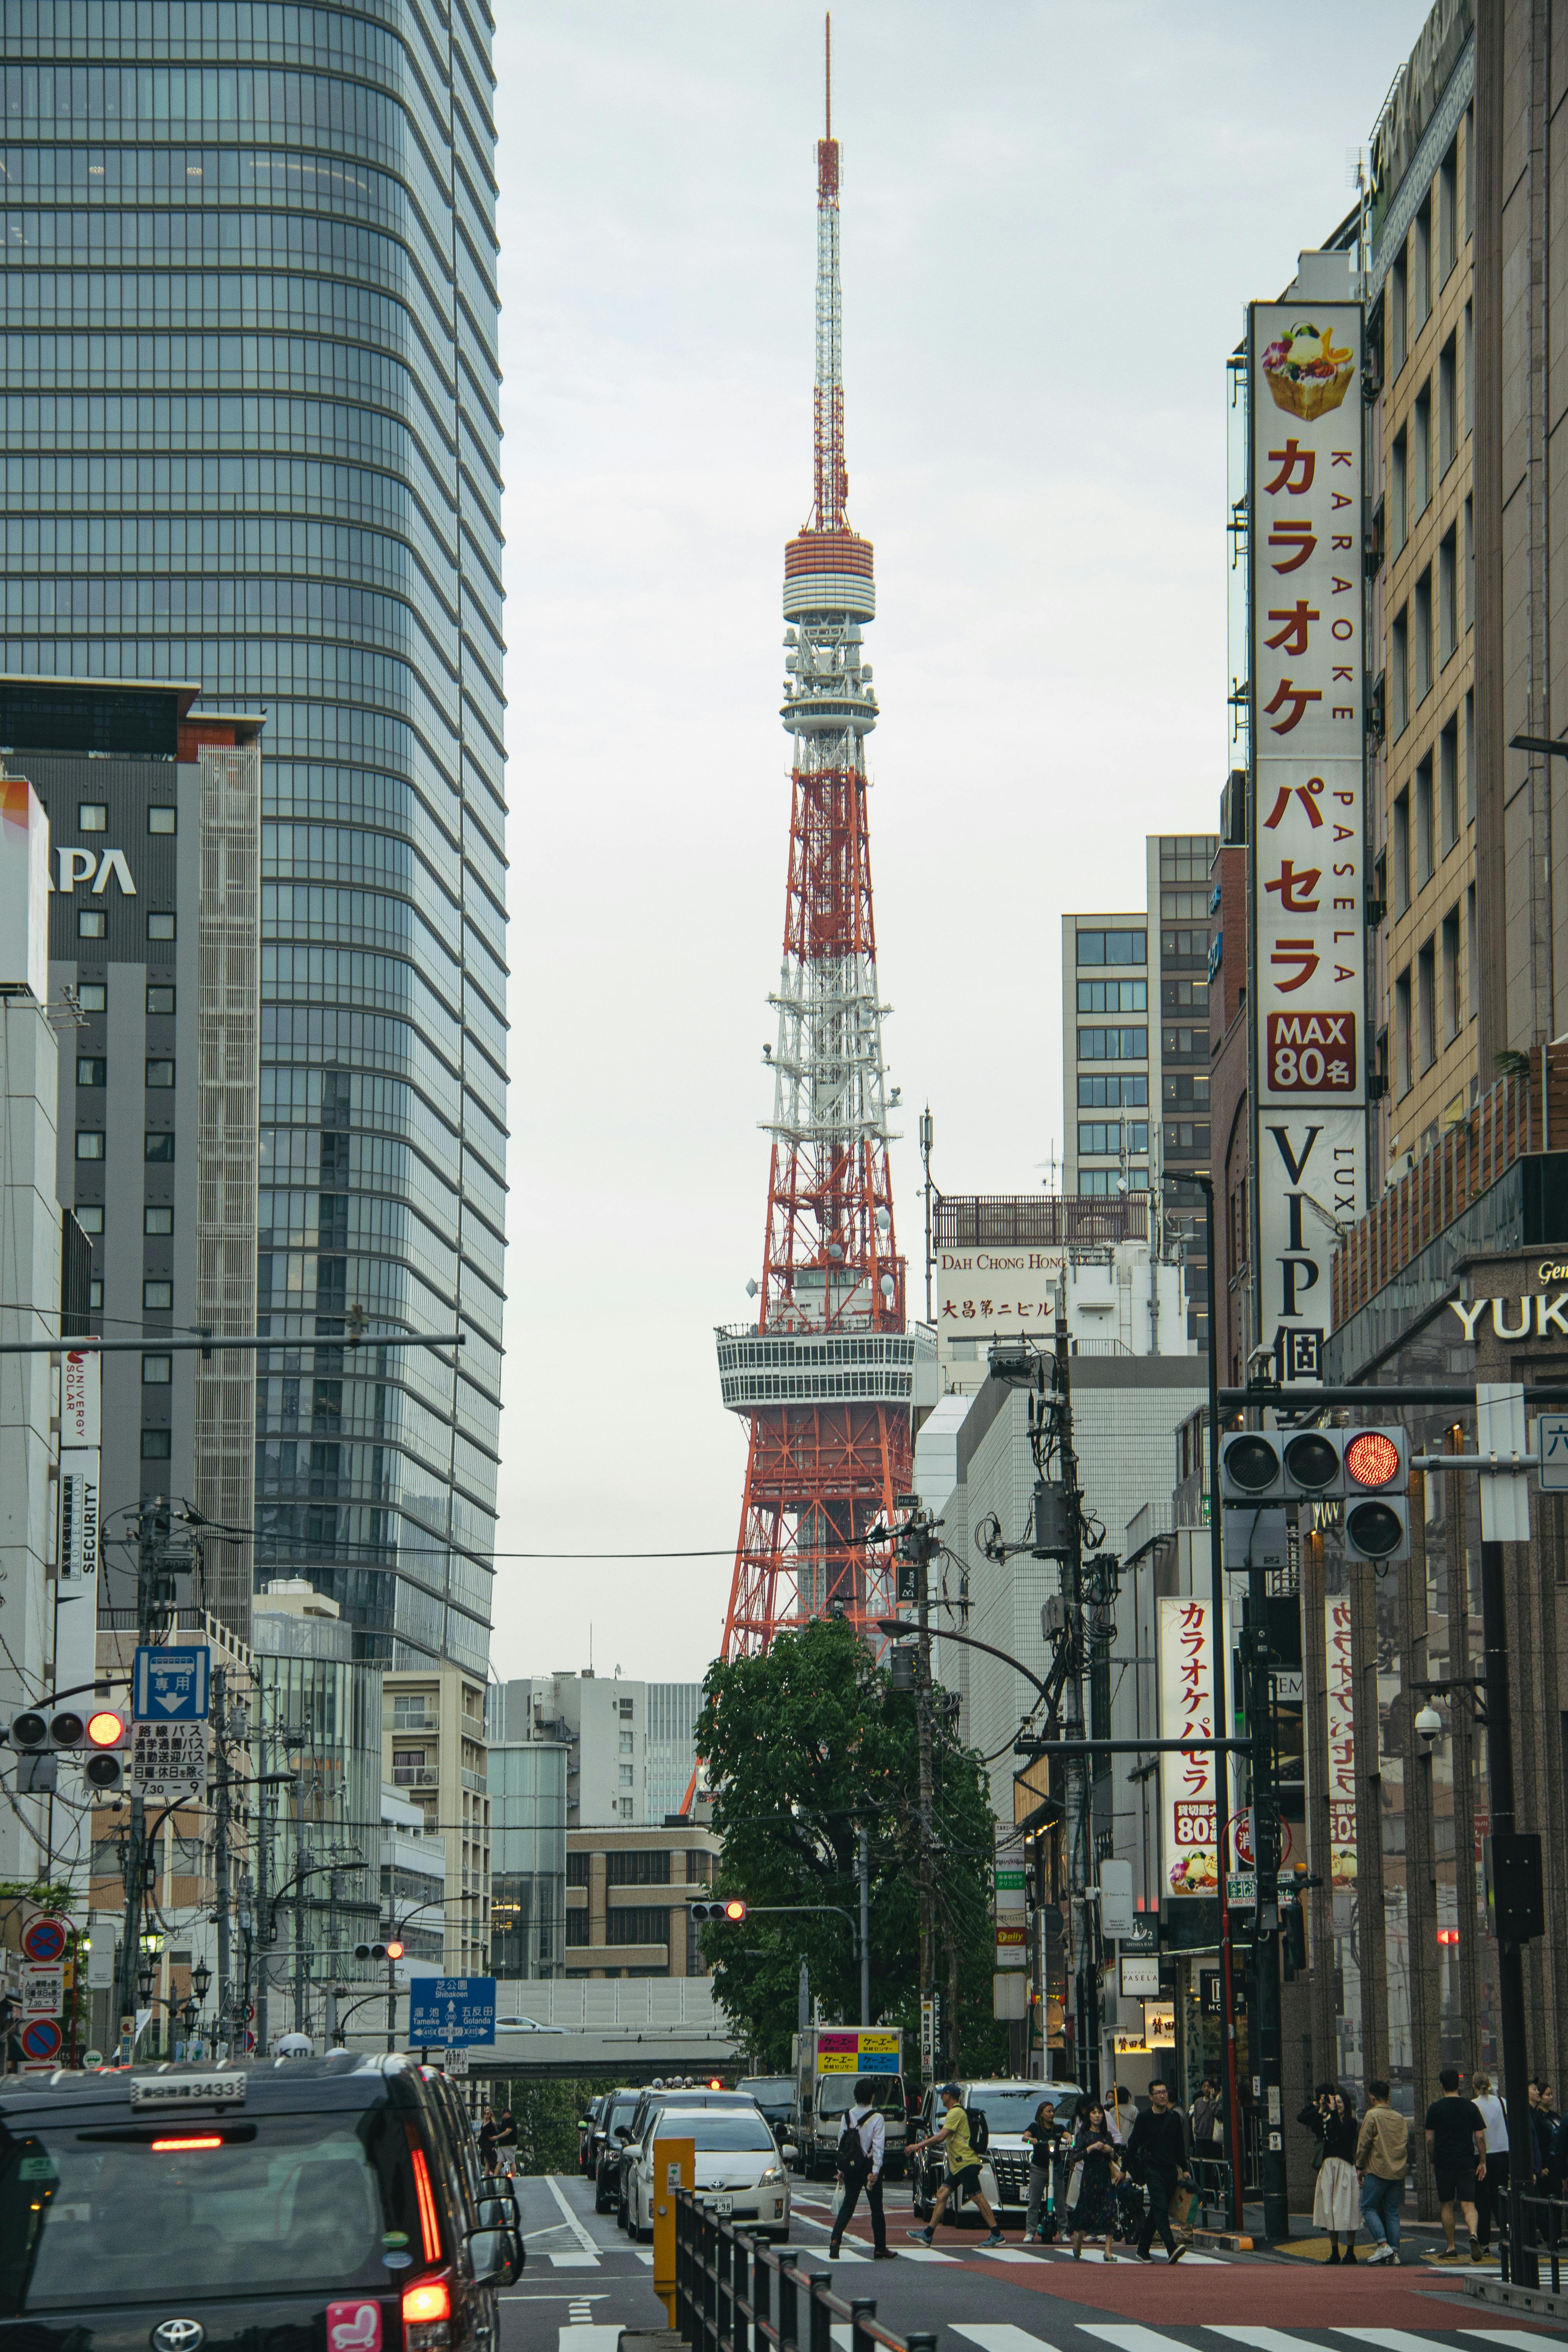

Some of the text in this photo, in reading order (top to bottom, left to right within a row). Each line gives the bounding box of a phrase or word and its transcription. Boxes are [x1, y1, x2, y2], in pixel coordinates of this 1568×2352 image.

[1331, 451, 1355, 983] KARAOKE PASELA
[48, 847, 136, 894] PA
[1275, 1017, 1346, 1044] MAX
[942, 1254, 973, 1270] DAH
[977, 1254, 1024, 1269] CHONG
[942, 1299, 1054, 1318] 大昌第二ビル
[66, 1365, 74, 1410] SOLAR
[76, 1365, 85, 1437] UNIVERGY
[62, 1475, 72, 1579] EXECUTIVE
[72, 1476, 82, 1578] PROTECTION
[83, 1482, 97, 1574] SECURITY
[155, 1677, 190, 1691] 専用
[139, 1725, 201, 1737] 路線バス
[135, 1738, 204, 1750] 通学通園バス
[135, 1751, 204, 1763] 通勤送迎バス
[436, 1980, 467, 1990] 芝公園
[414, 2007, 439, 2017] 溜池
[462, 2007, 493, 2016] 五反田
